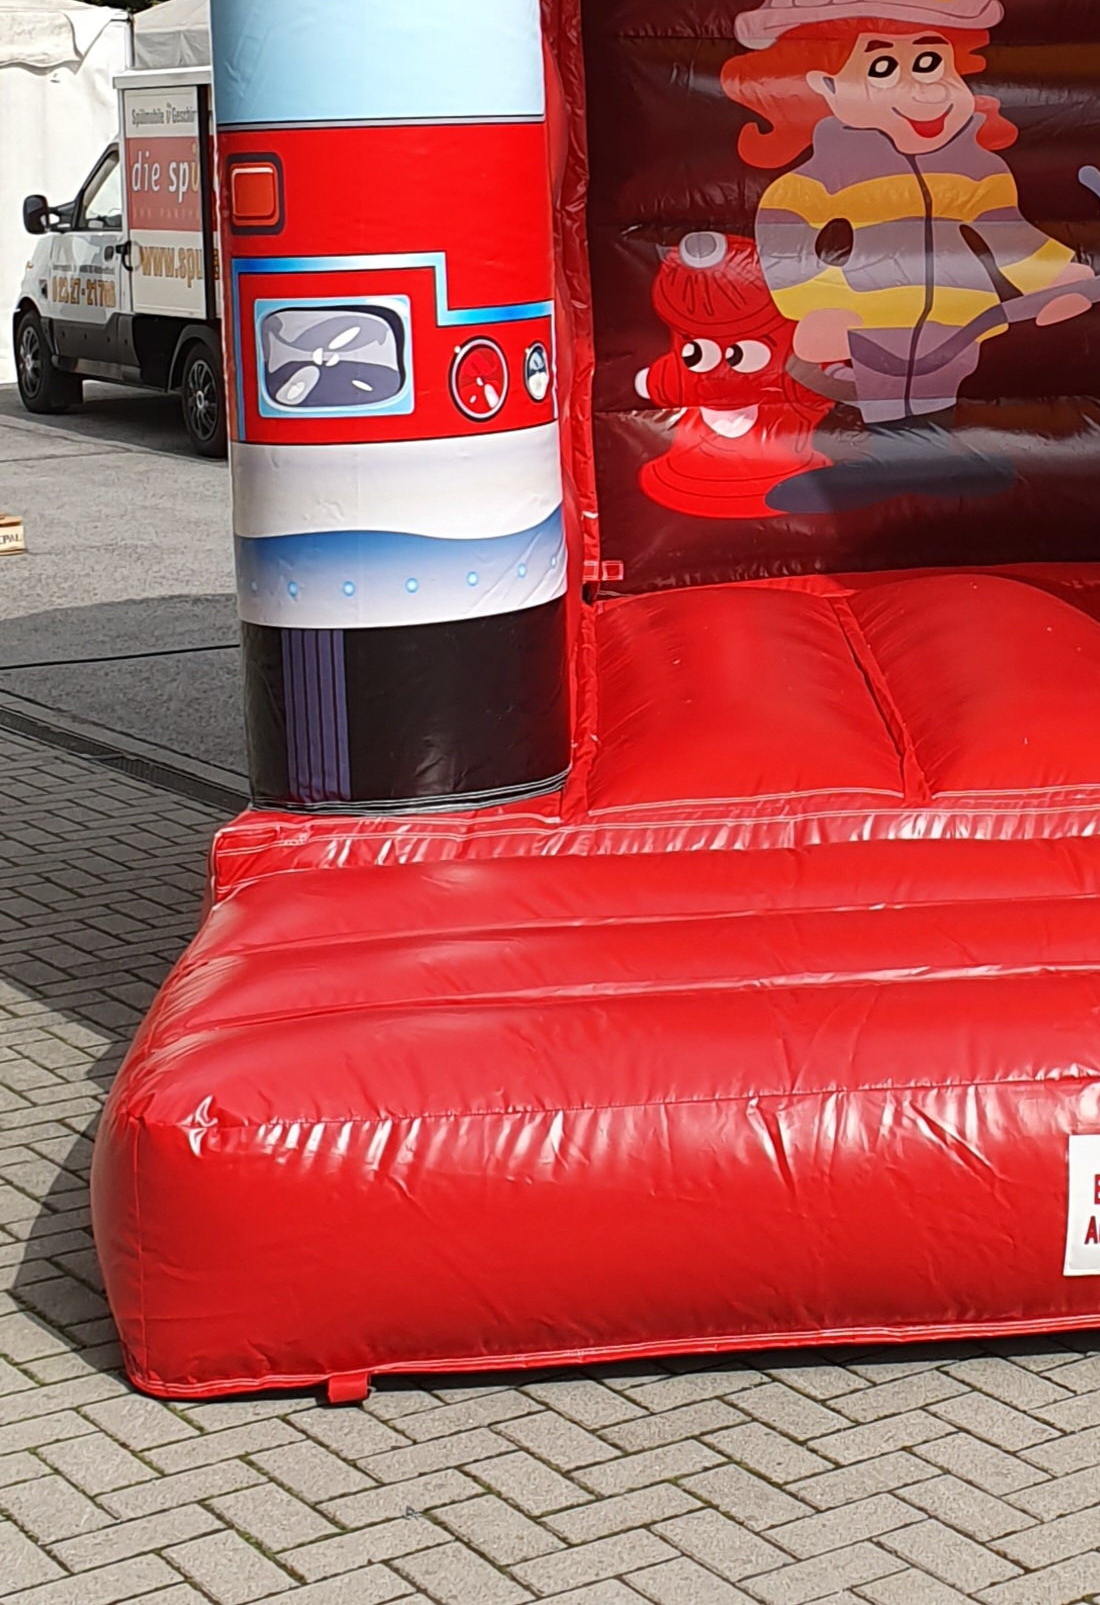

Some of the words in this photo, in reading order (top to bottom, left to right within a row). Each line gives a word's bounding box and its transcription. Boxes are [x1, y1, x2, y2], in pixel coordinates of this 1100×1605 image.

[132, 150, 160, 192] die
[168, 142, 199, 203] spü
[140, 246, 203, 288] www.spu
